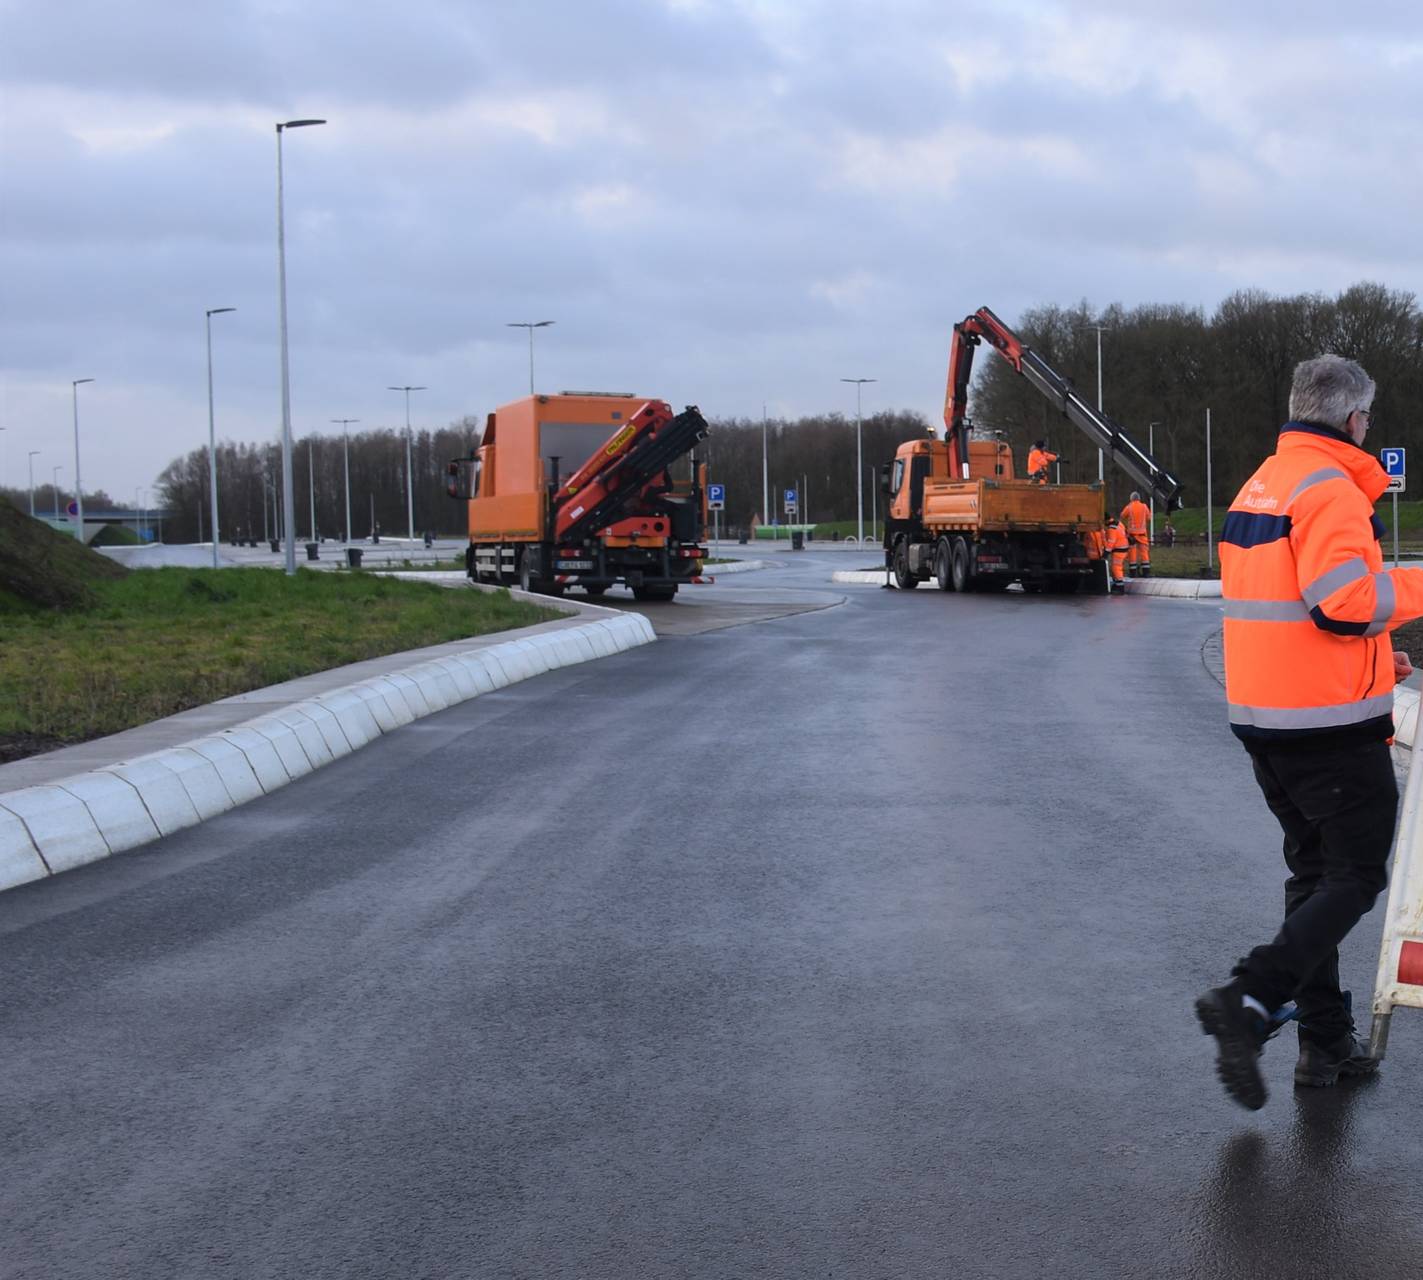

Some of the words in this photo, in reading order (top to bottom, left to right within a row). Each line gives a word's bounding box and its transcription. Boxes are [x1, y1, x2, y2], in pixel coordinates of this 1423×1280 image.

[1386, 452, 1399, 473] P
[711, 487, 721, 499] P
[786, 491, 793, 501] P
